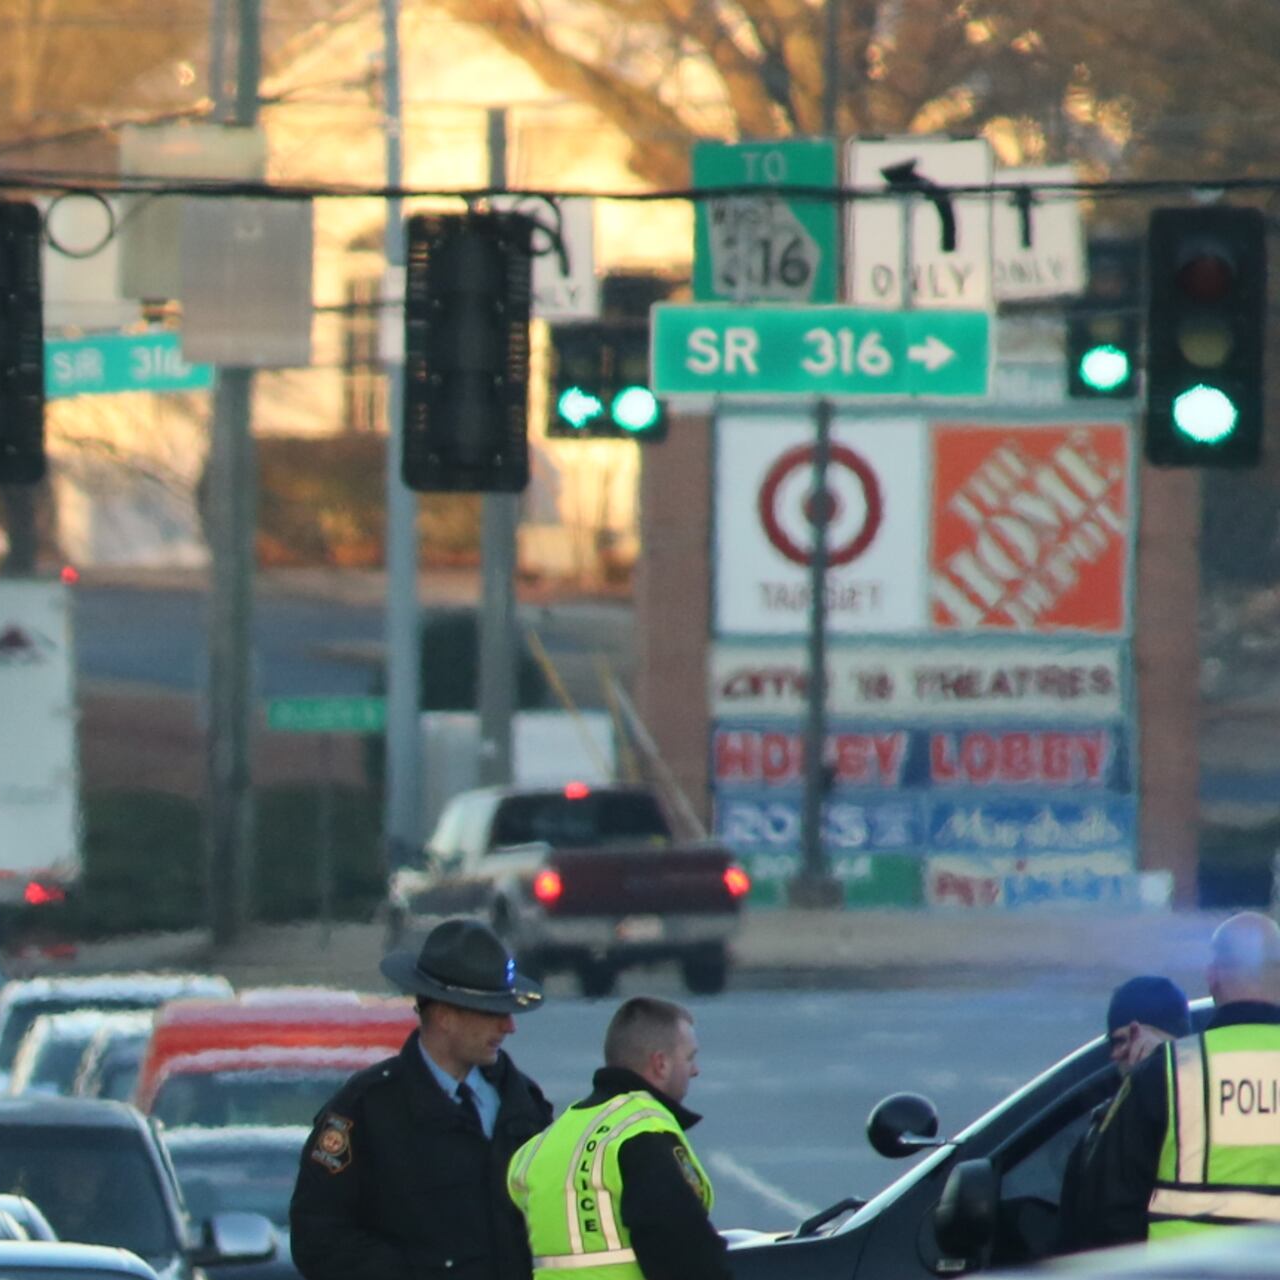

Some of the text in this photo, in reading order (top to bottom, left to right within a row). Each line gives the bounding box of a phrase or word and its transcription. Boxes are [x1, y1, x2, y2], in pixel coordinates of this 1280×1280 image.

[742, 151, 787, 182] TO
[52, 348, 105, 386] SR
[685, 327, 894, 375] SR 316
[716, 730, 1109, 786] HOBY LOBBY
[1218, 1079, 1280, 1116] POLI
[580, 1125, 610, 1233] POLICE
